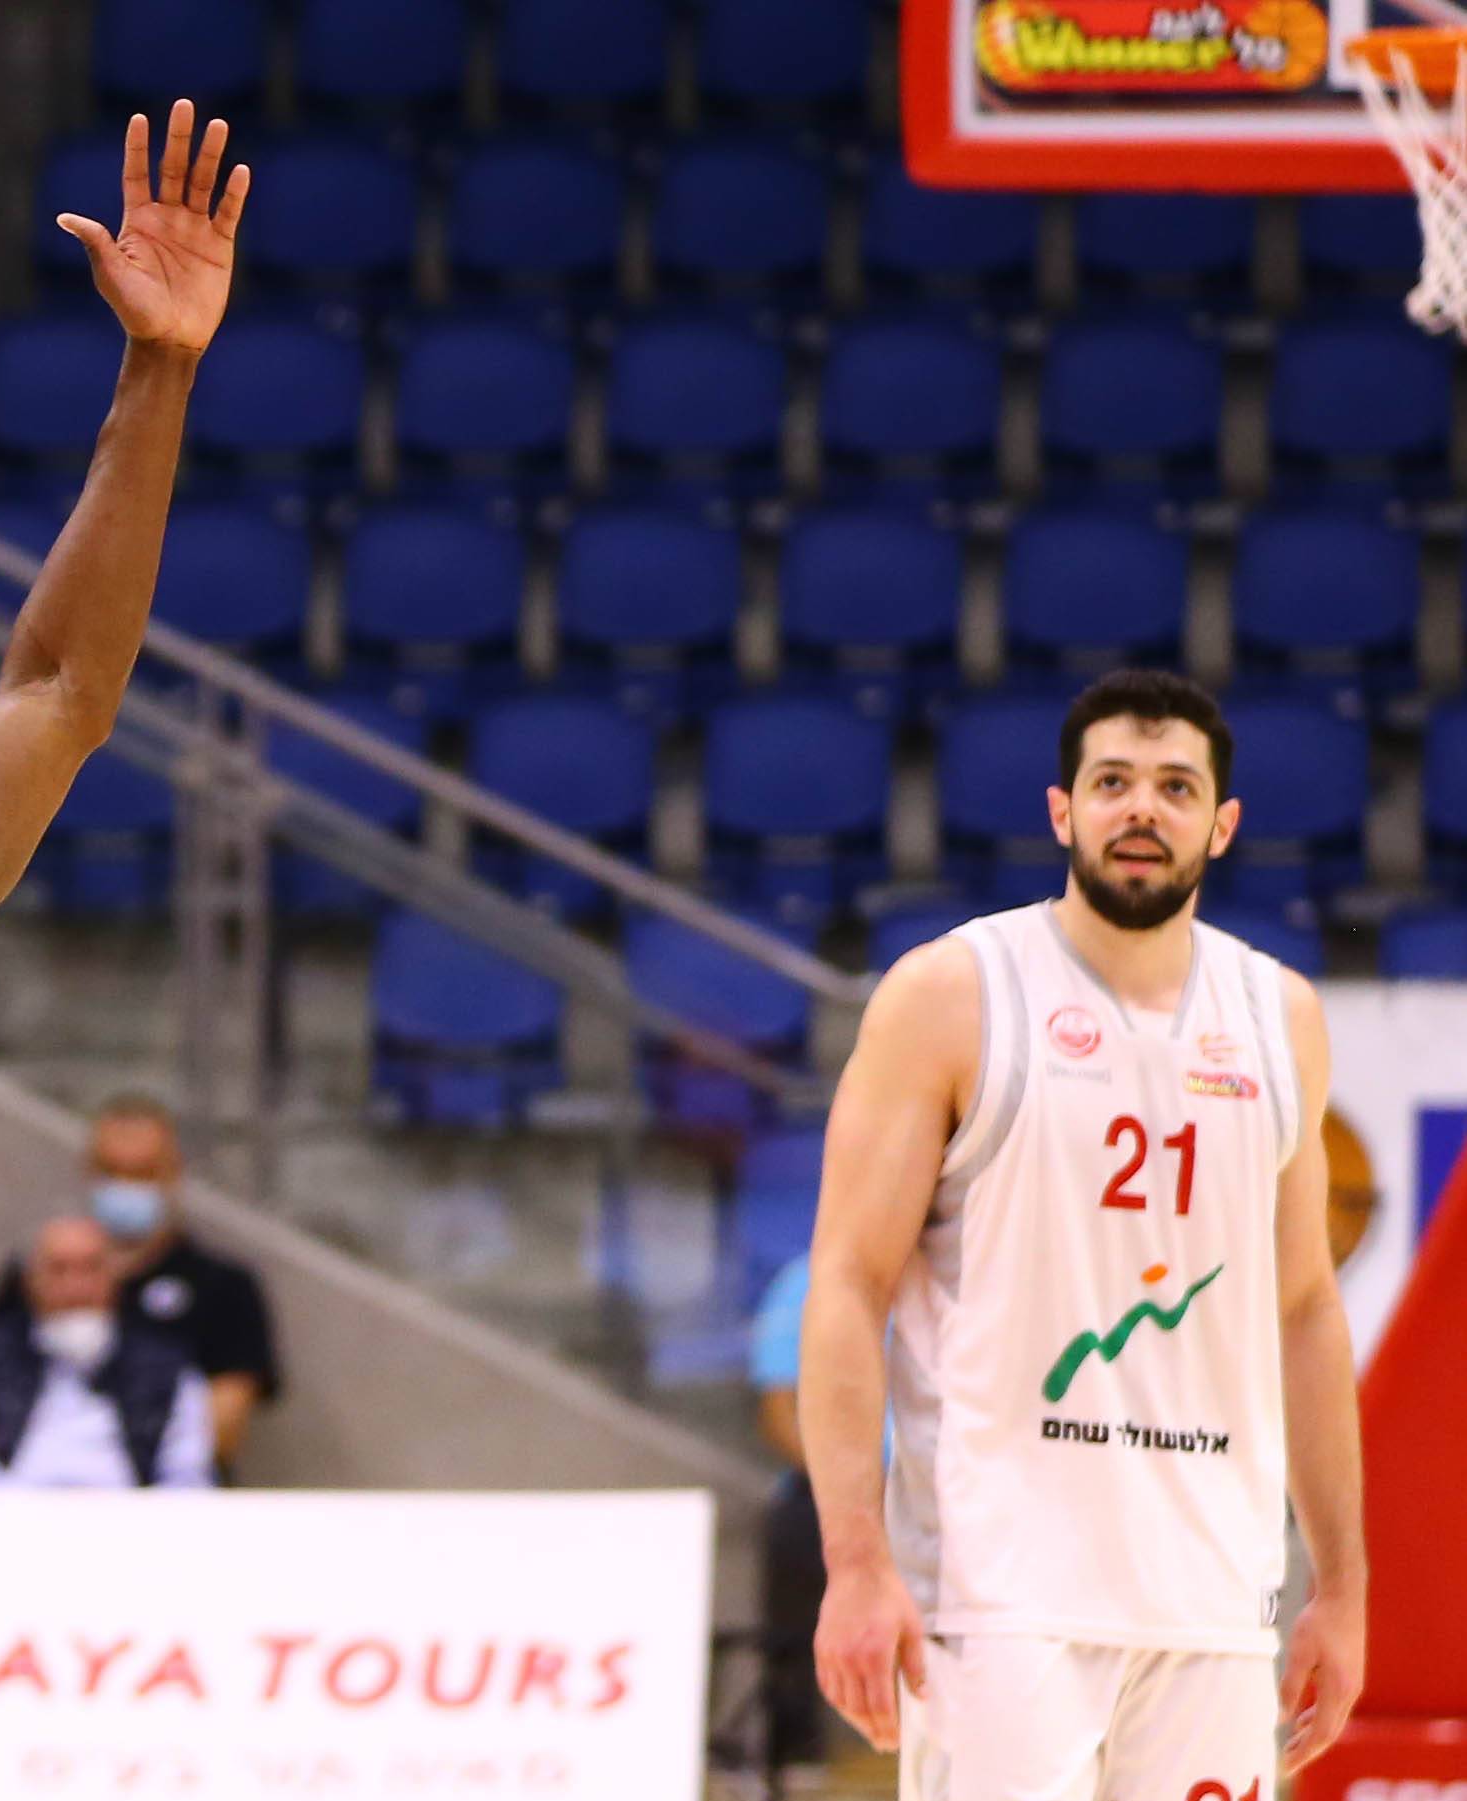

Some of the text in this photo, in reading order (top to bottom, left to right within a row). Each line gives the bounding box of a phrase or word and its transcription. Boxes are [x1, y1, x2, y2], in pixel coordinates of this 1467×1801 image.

[1017, 16, 1228, 72] Winner
[1099, 1112, 1197, 1217] 21
[1041, 1417, 1110, 1443] שחם
[254, 1634, 636, 1712] TOURS
